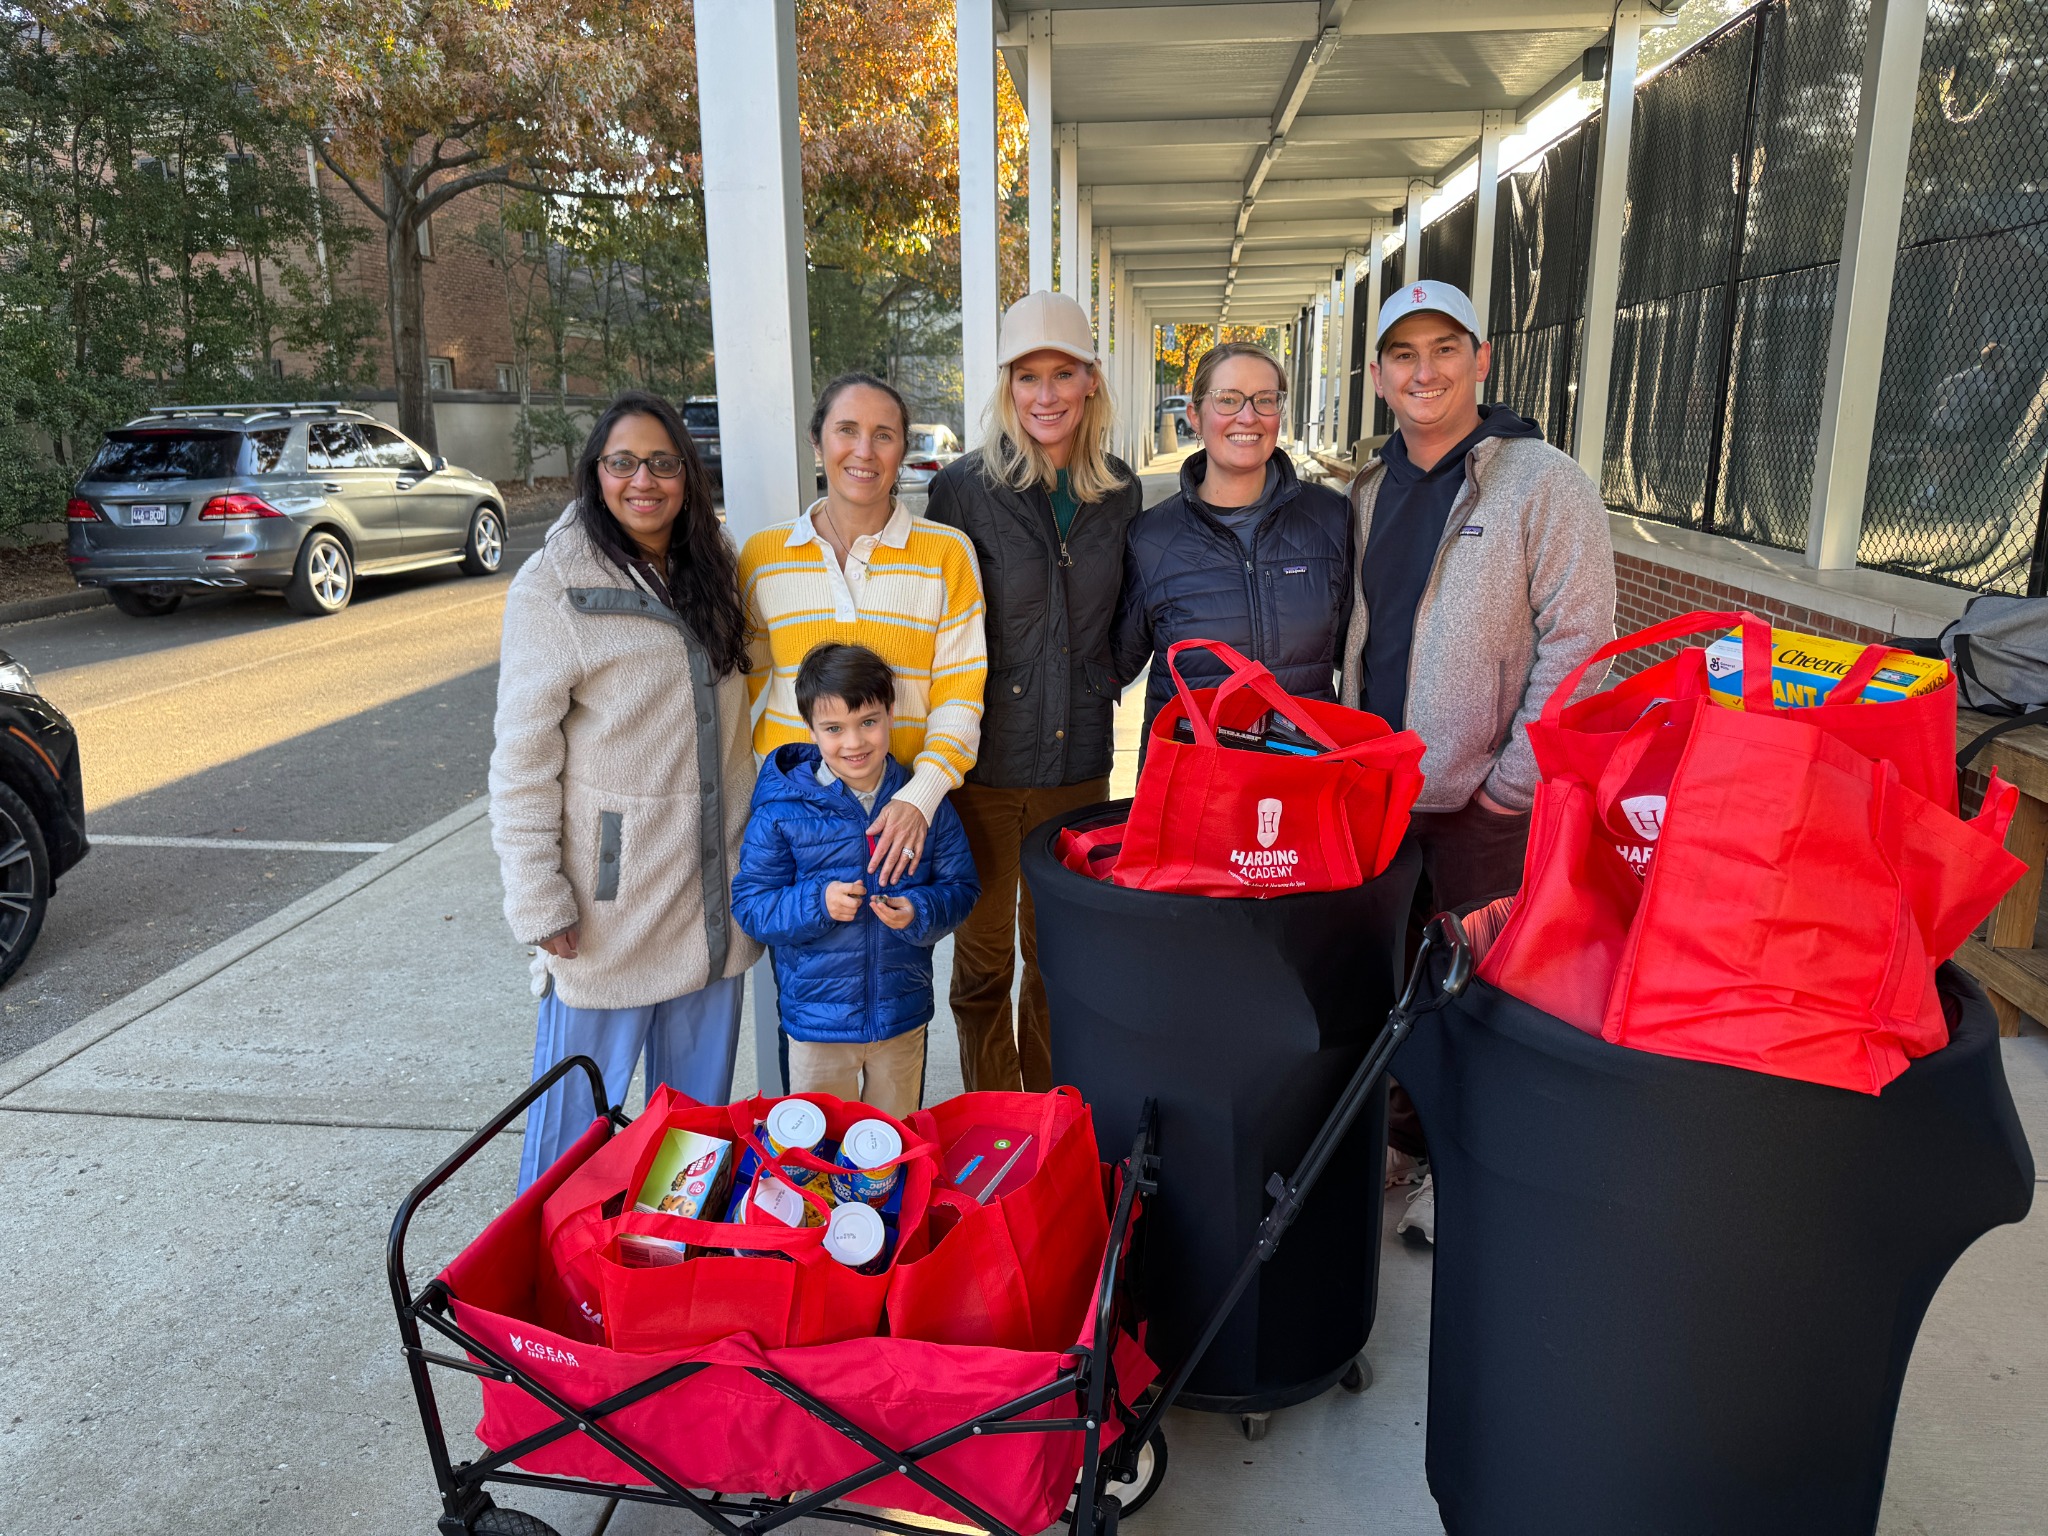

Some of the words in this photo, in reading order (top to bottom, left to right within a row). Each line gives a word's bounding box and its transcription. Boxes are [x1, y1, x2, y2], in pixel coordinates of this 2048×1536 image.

[1778, 649, 1854, 676] Cheerio
[1772, 679, 1817, 707] ANT
[1230, 849, 1299, 867] HARDING
[1239, 865, 1293, 880] ACADEMY
[525, 1340, 579, 1366] CGEAR
